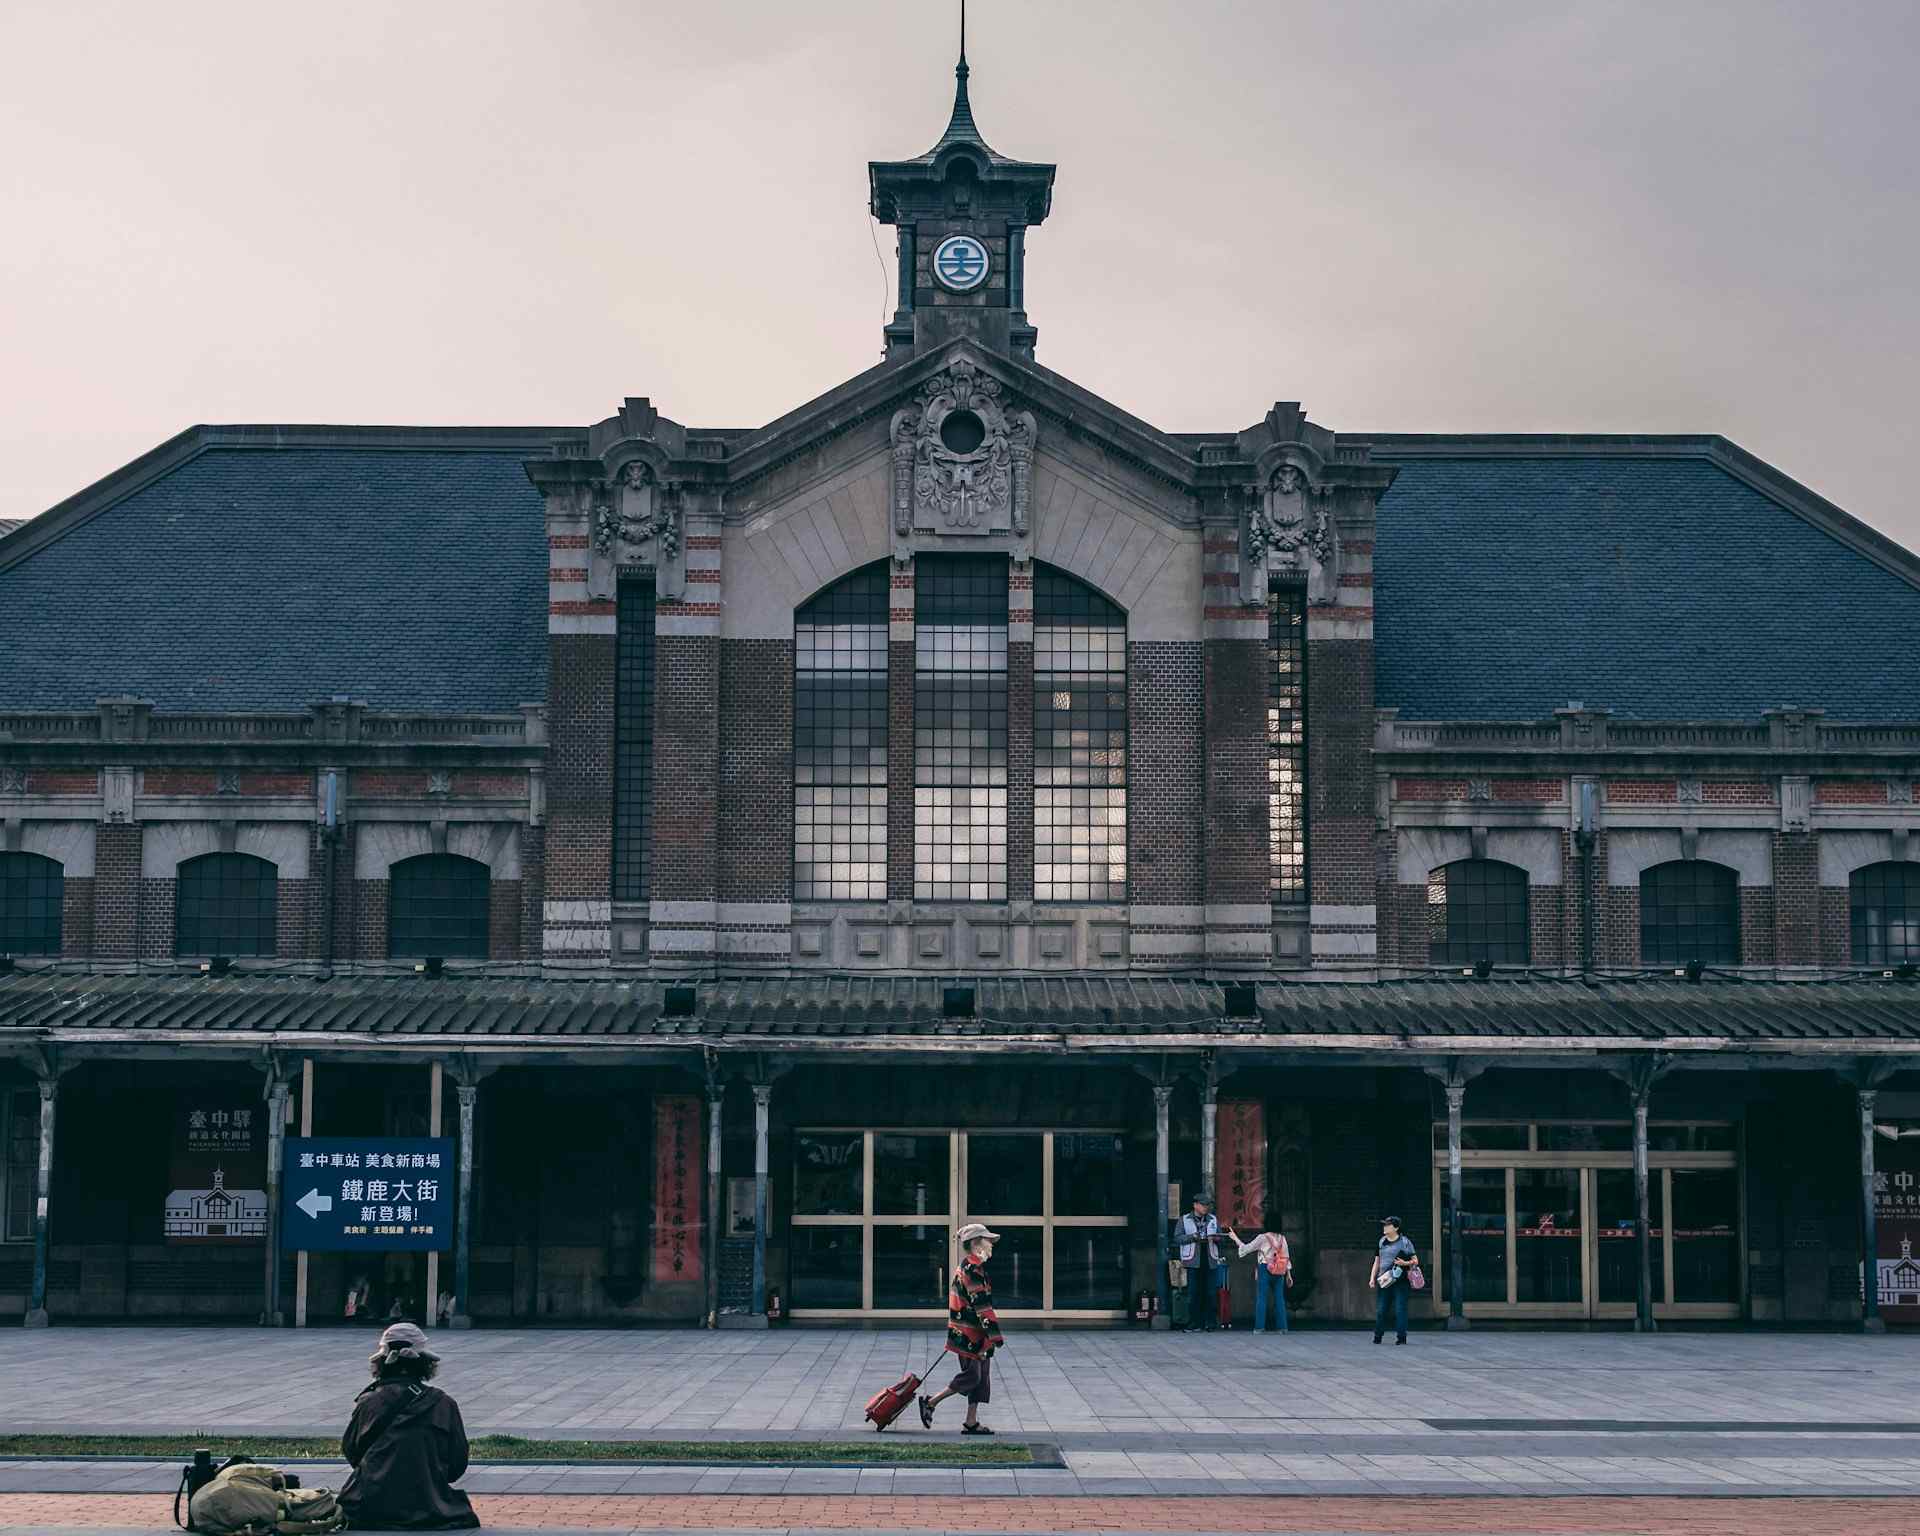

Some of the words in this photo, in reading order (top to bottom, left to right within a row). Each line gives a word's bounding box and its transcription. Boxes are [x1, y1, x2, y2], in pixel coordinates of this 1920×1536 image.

[188, 1109, 252, 1128] 臺中驛
[300, 1153, 360, 1168] 臺中車站
[365, 1153, 441, 1168] 美食新商場
[341, 1179, 439, 1202] 鐵鹿大街
[360, 1206, 418, 1222] 新登場!
